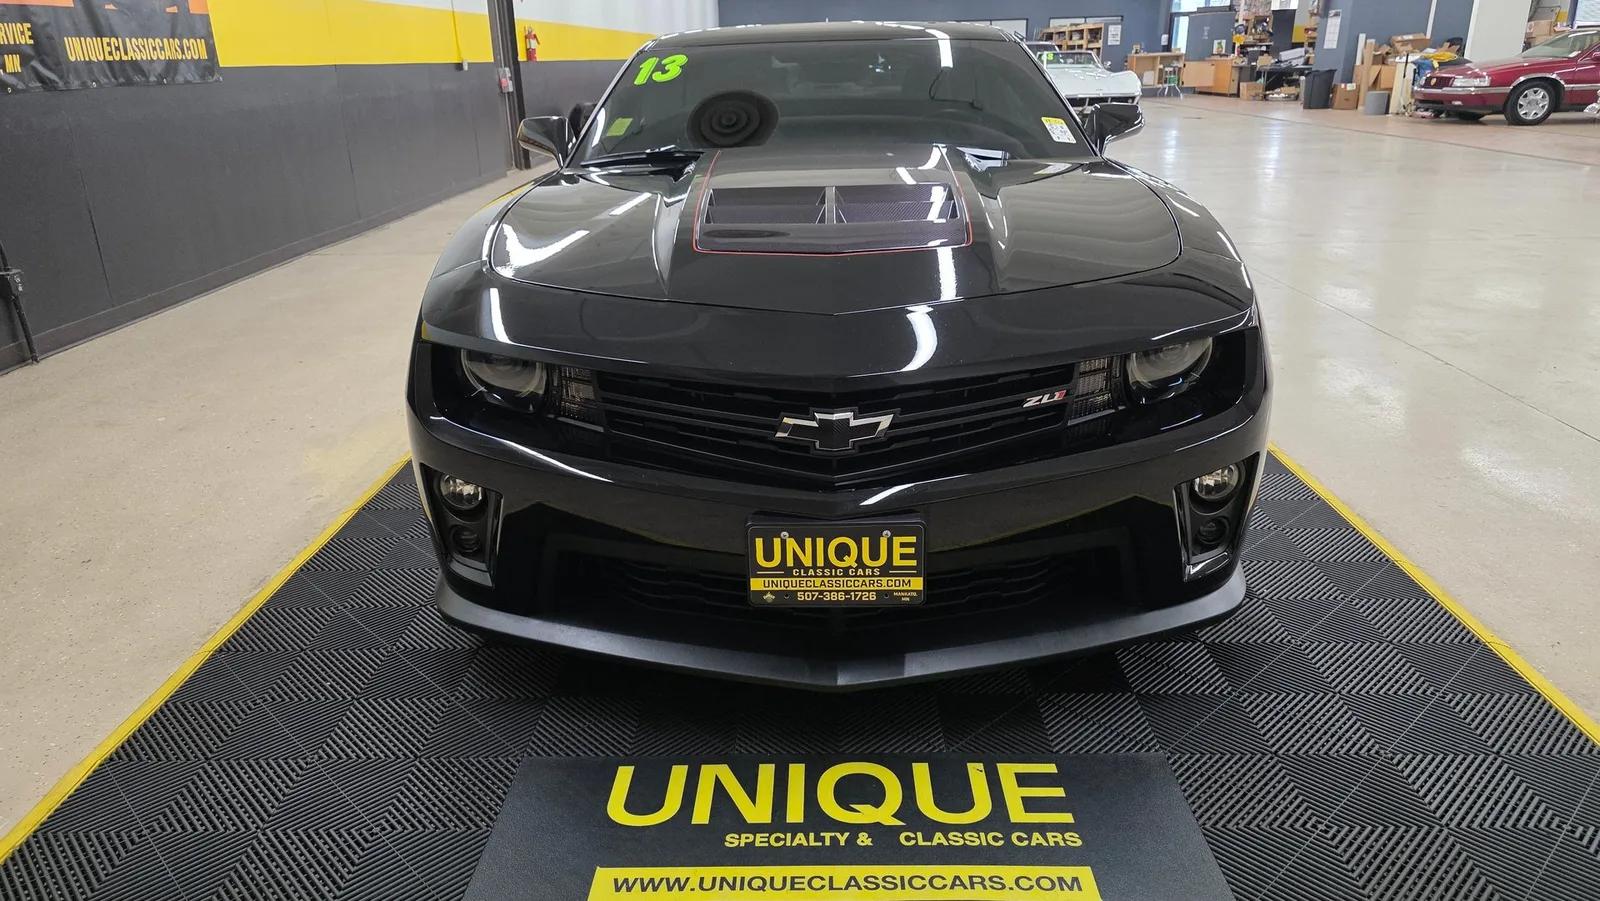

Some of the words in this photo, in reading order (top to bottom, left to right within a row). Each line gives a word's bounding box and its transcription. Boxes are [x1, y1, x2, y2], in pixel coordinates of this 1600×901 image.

[64, 36, 208, 62] UNIQUECLASSICCARS.COM
[4, 54, 21, 72] MN
[633, 54, 689, 86] 13
[1022, 389, 1067, 408] ZL1
[755, 536, 917, 568] UNIQUE
[793, 568, 844, 576] CLASSIC
[849, 568, 881, 576] CARS
[763, 579, 911, 590] UNIQUECLASSICCARS.COM
[797, 591, 877, 601] 507-386-1726
[606, 761, 1075, 826] UNIQUE
[724, 832, 850, 848] SPECIALTY
[857, 832, 873, 846] &
[899, 831, 1005, 846] CLASSIC
[1011, 831, 1083, 847] CARS
[613, 875, 1083, 893] WWW.UNIQUECLASSICCARS.COM
